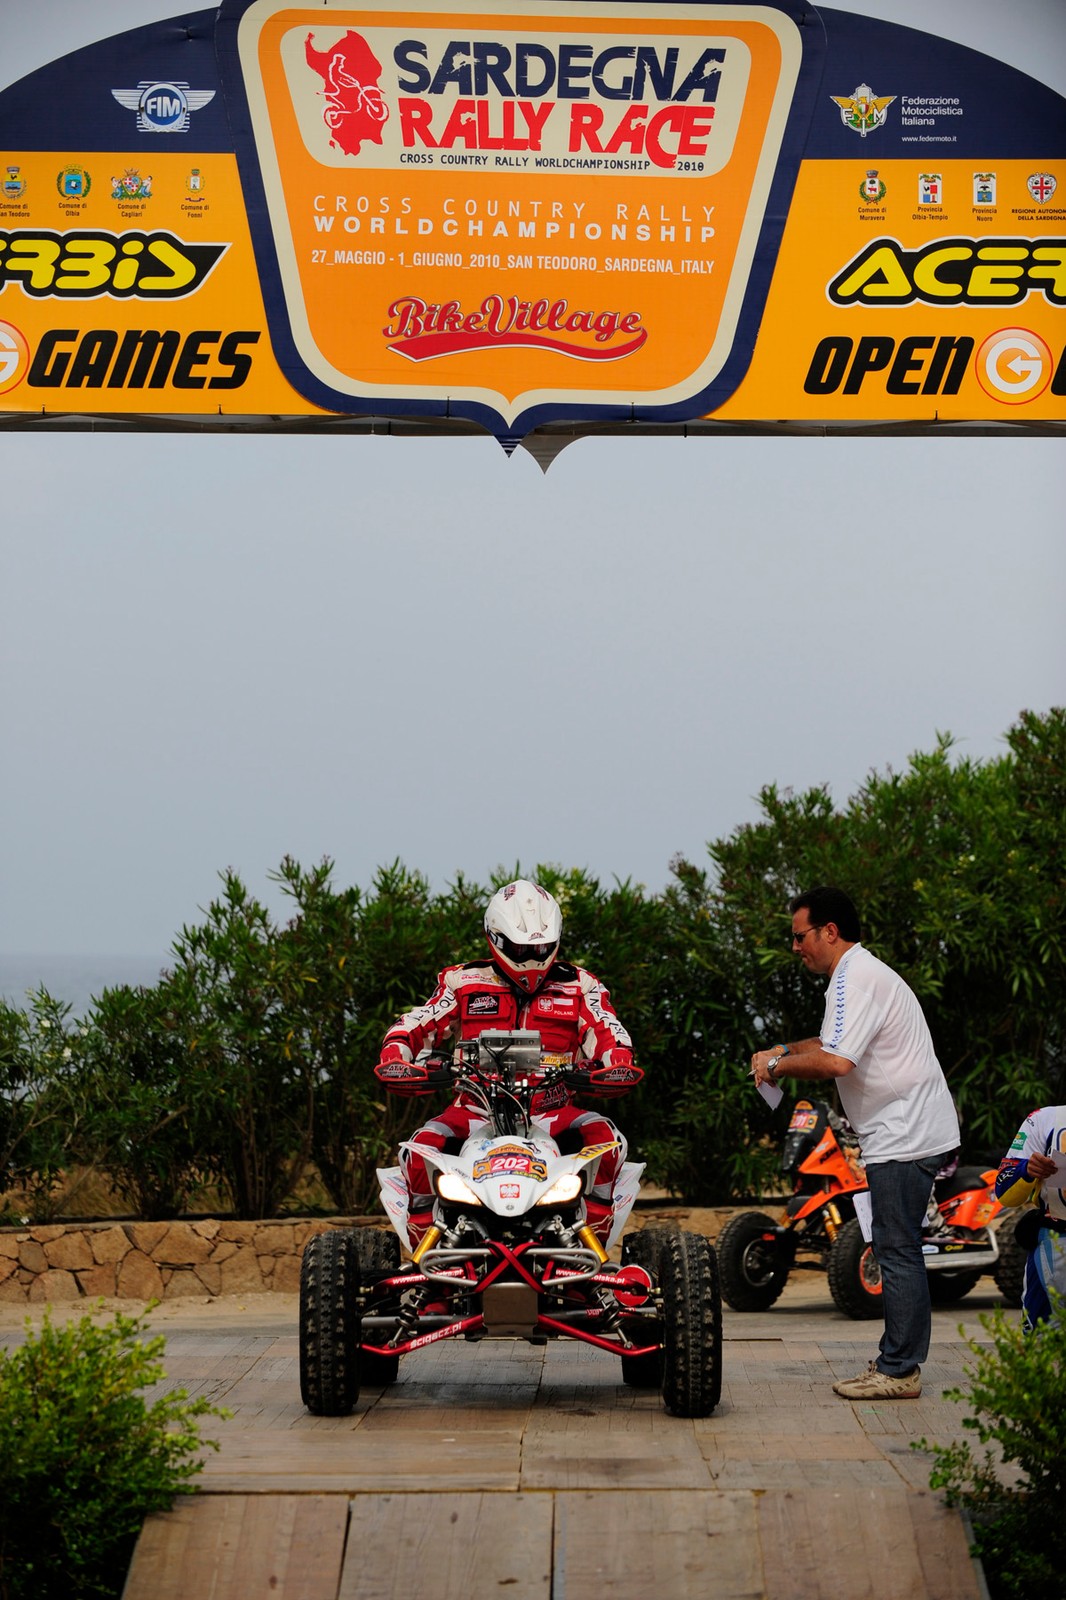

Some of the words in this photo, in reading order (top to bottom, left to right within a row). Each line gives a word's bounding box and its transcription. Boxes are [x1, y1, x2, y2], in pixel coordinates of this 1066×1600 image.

[393, 40, 727, 102] SARDEGNA
[146, 95, 181, 118] FIM
[901, 96, 960, 106] Federazione
[901, 106, 963, 116] Motociclistica
[901, 116, 936, 126] Italiana
[397, 97, 556, 151] RALLY
[568, 103, 716, 168] RACE
[901, 135, 957, 143] www.federmoto.it
[400, 153, 434, 164] CROSS
[440, 155, 489, 166] COUNTRY
[495, 156, 530, 168] RALLY
[535, 157, 651, 170] WORLDCHAMPIONSHIP
[677, 161, 705, 172] 2010
[121, 211, 143, 219] Cagliari
[313, 195, 413, 215] CROSS
[443, 198, 586, 220] COUNTRY
[616, 203, 716, 222] RALLY
[912, 213, 949, 221] Olbia-Tempio
[313, 215, 716, 243] WORLDCHAMPIONSHIP
[311, 250, 386, 266] 27_MAGGIO
[398, 252, 533, 271] 1_GIUGNO_2010_SAN
[536, 255, 715, 276] TEODORO_SARDEGNA_ITALY
[26, 329, 262, 390] GAMES
[803, 336, 975, 396] OPEN
[491, 1157, 529, 1171] 202
